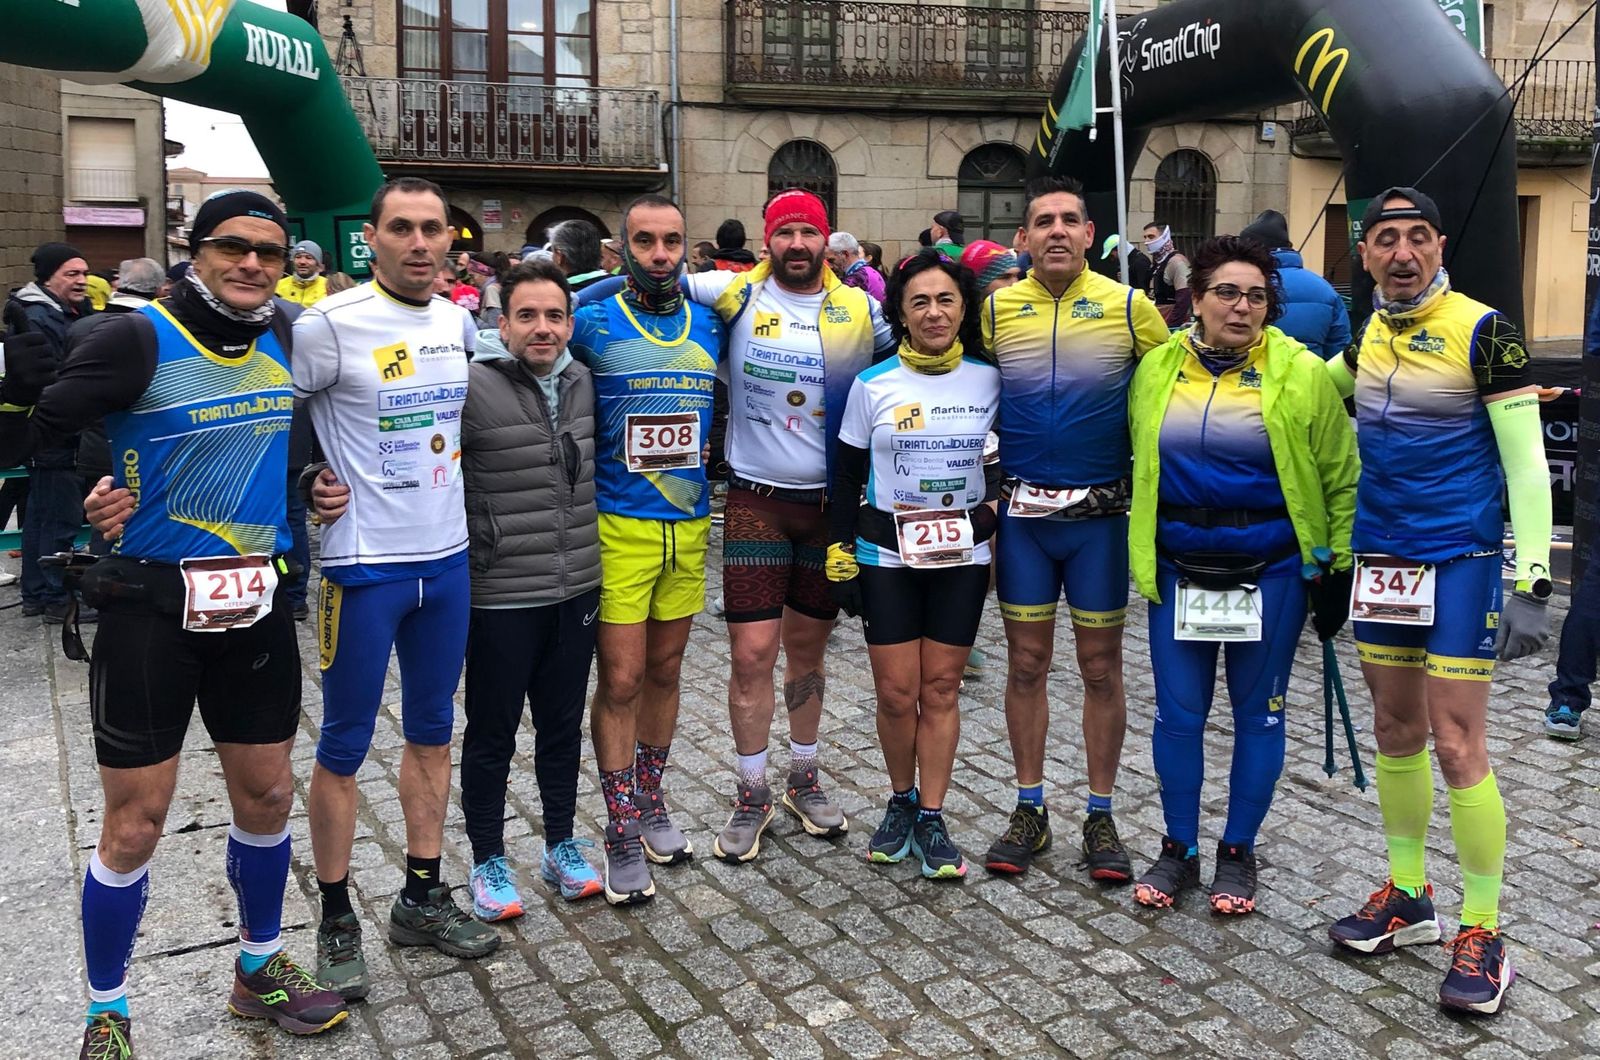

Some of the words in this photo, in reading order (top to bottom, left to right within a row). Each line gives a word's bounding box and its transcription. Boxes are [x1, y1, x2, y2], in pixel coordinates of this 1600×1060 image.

[242, 21, 320, 81] RURAL
[1141, 18, 1220, 71] SmartChip
[752, 348, 799, 365] TRIATLON
[627, 377, 677, 390] TRIATLON
[387, 390, 435, 407] TRIATLON
[187, 400, 252, 425] TRIATLON
[639, 425, 693, 449] 308
[898, 439, 945, 450] TRIATLON
[123, 448, 142, 505] UERO
[914, 520, 961, 546] 215
[208, 570, 267, 601] 214
[1369, 569, 1425, 596] 347
[1188, 591, 1253, 616] 444
